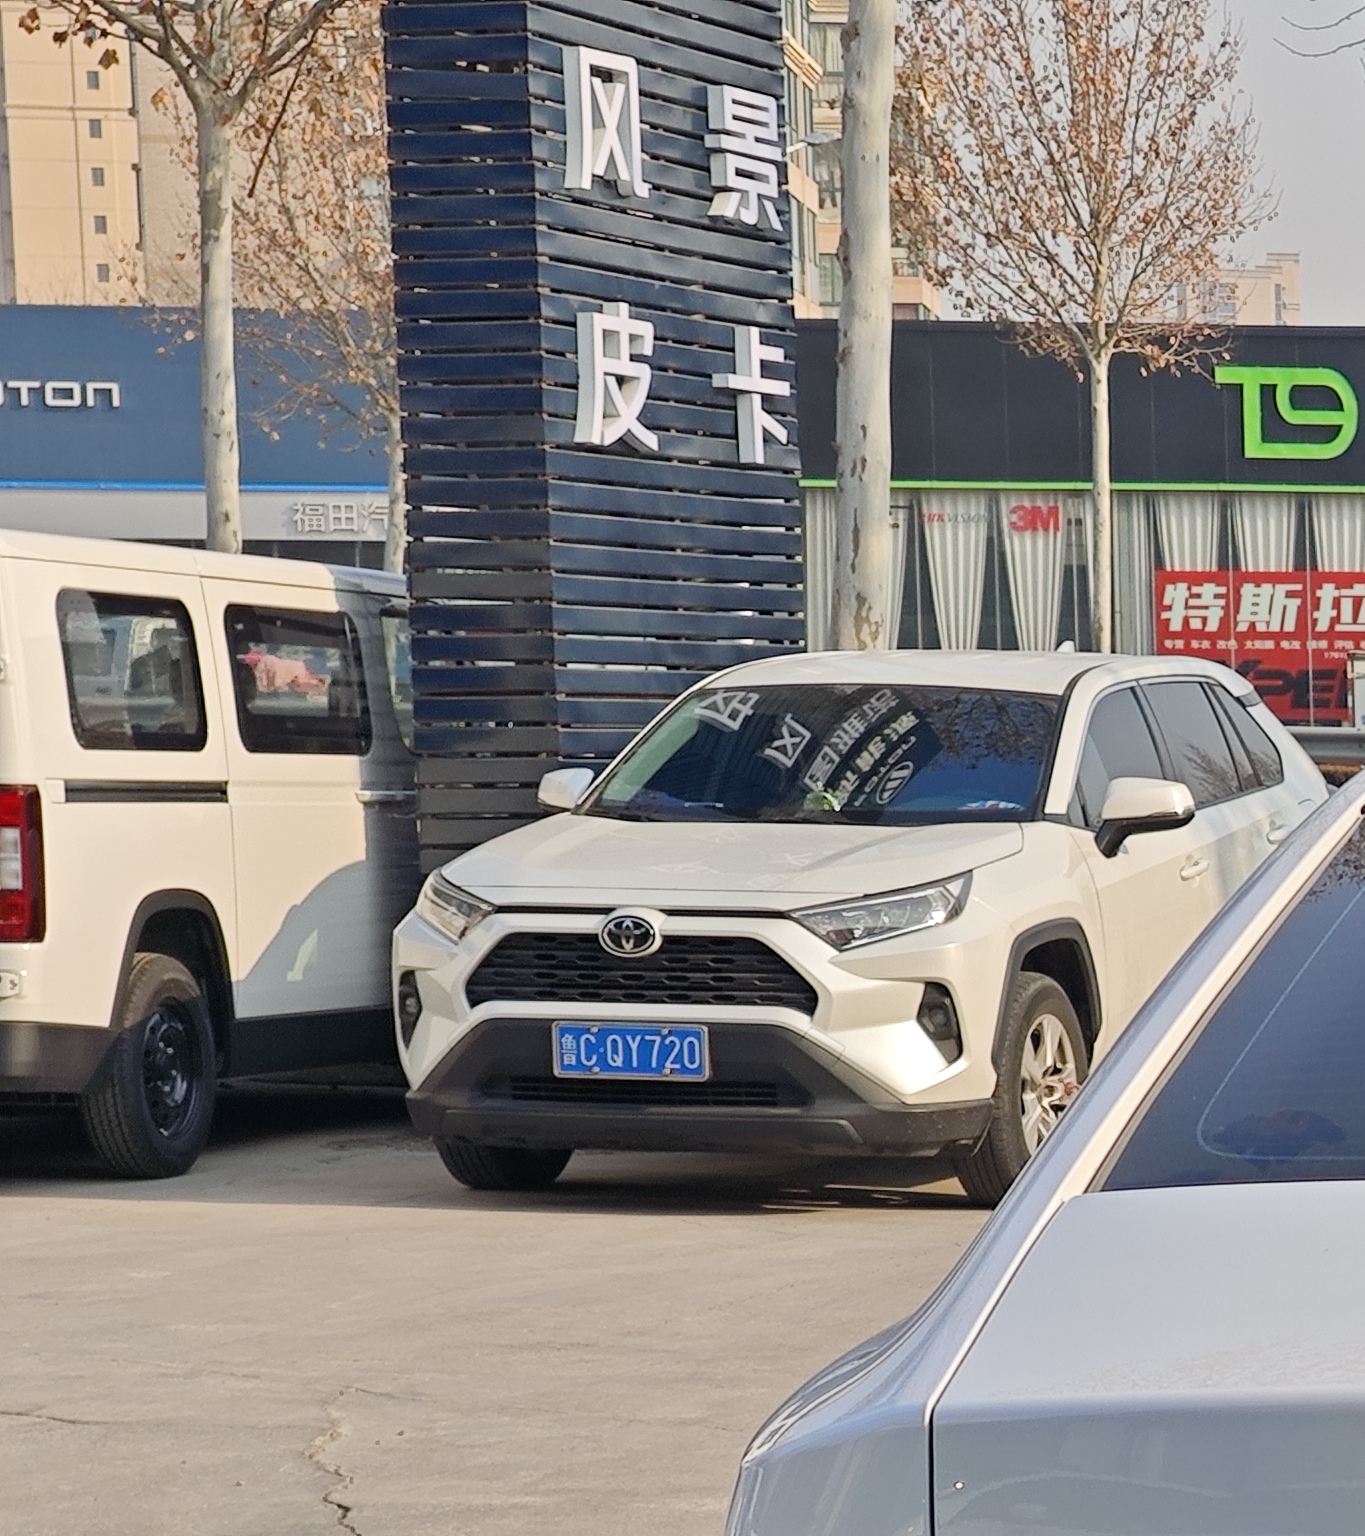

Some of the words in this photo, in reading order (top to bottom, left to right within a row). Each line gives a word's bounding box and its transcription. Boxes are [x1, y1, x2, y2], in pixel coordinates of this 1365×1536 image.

[564, 46, 783, 231] 风景
[0, 380, 121, 408] TON
[575, 303, 792, 465] 皮卡
[1009, 504, 1060, 532] 3M
